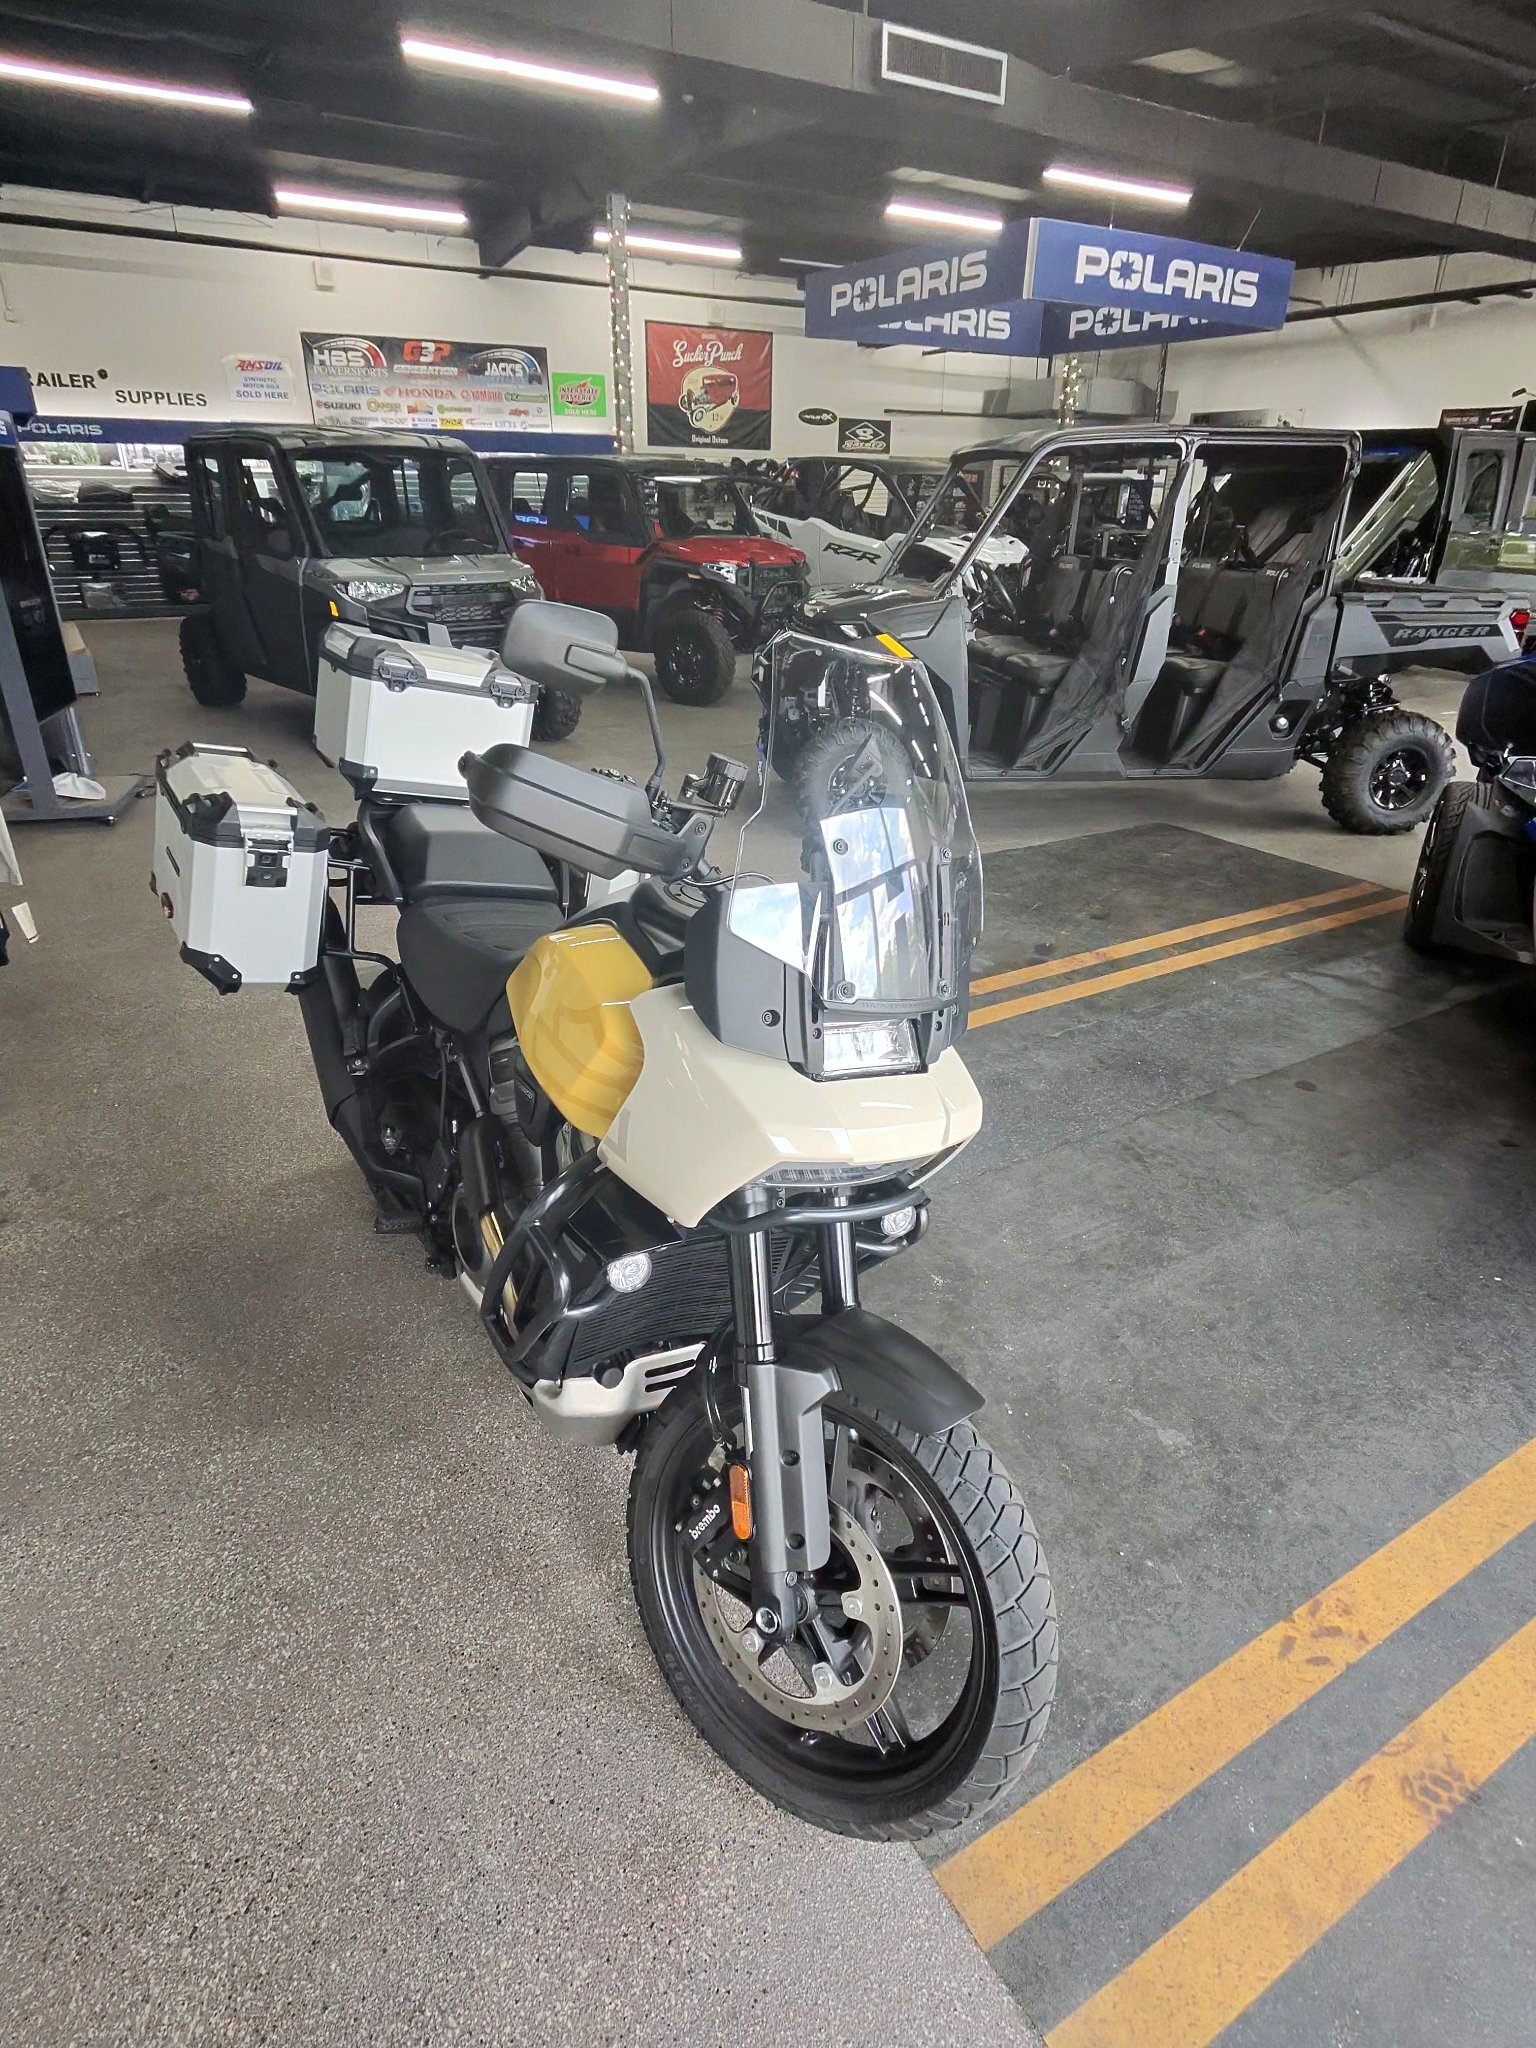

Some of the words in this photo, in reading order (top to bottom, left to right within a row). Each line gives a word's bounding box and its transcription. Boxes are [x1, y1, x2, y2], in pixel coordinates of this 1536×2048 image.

[830, 250, 988, 317] POLARIS
[1075, 244, 1259, 308] POLARIS
[878, 308, 1011, 340] LARIS
[1068, 306, 1209, 340] POLA
[312, 348, 365, 367] HBS
[672, 339, 709, 368] Sucker
[704, 340, 744, 367] Punch
[234, 359, 283, 371] AMSOIL
[313, 365, 388, 378] POWERSPORTS
[484, 361, 523, 377] JACK'S
[27, 372, 97, 389] AILER
[236, 390, 261, 399] SOLD
[264, 391, 290, 400] HERE
[311, 383, 381, 396] POLARIS
[398, 386, 455, 399] HONDA
[471, 389, 503, 401] YAMAHA
[115, 389, 207, 407] SUPPLIES
[323, 401, 362, 411] SUZUKI
[17, 422, 103, 435] POLARIS
[822, 542, 882, 565] RZR
[1394, 626, 1490, 639] RANGER
[688, 1504, 721, 1541] brembo
